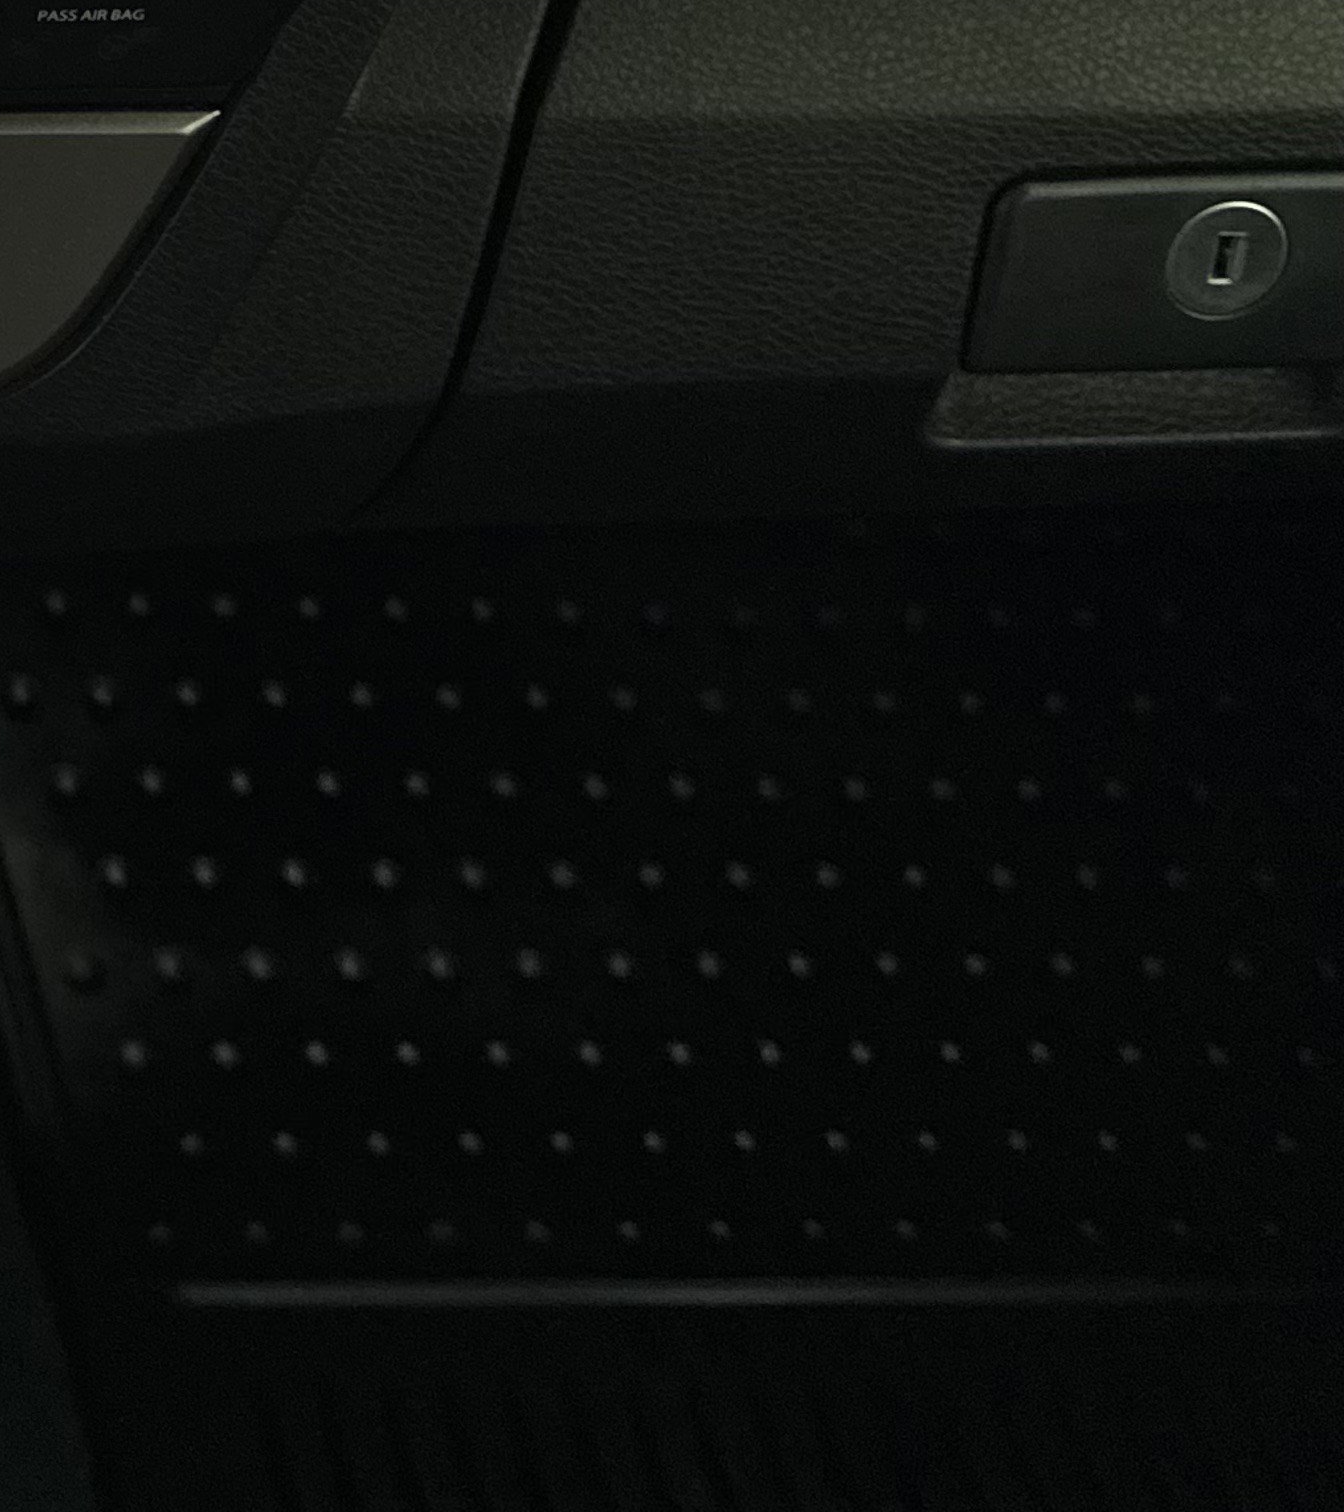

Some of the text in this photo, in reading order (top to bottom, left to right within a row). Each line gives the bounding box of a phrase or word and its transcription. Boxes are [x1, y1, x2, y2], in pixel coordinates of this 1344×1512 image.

[37, 9, 145, 22] PASS AIR BAG
